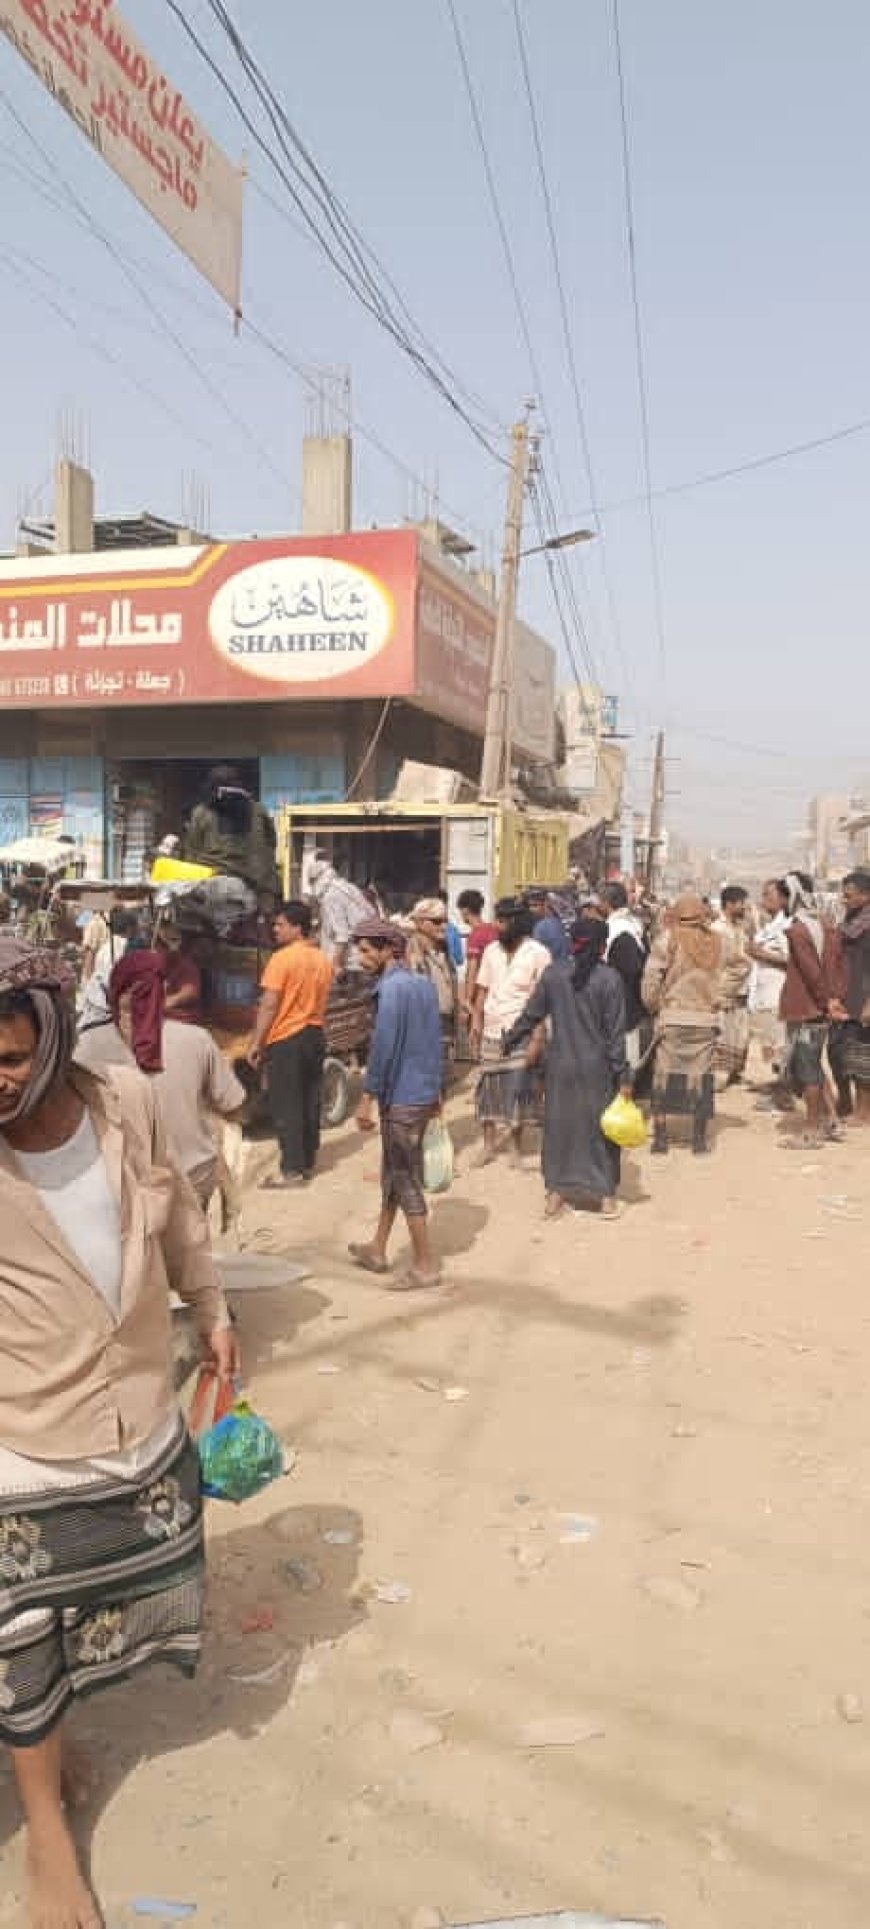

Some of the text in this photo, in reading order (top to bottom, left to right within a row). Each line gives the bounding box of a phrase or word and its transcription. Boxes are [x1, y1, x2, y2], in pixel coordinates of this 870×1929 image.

[91, 82, 198, 212] ماجستير
[149, 75, 204, 174] يعلن
[0, 598, 182, 651] محلات المن
[232, 577, 368, 628] شاهين
[229, 632, 369, 653] SHAHEEN
